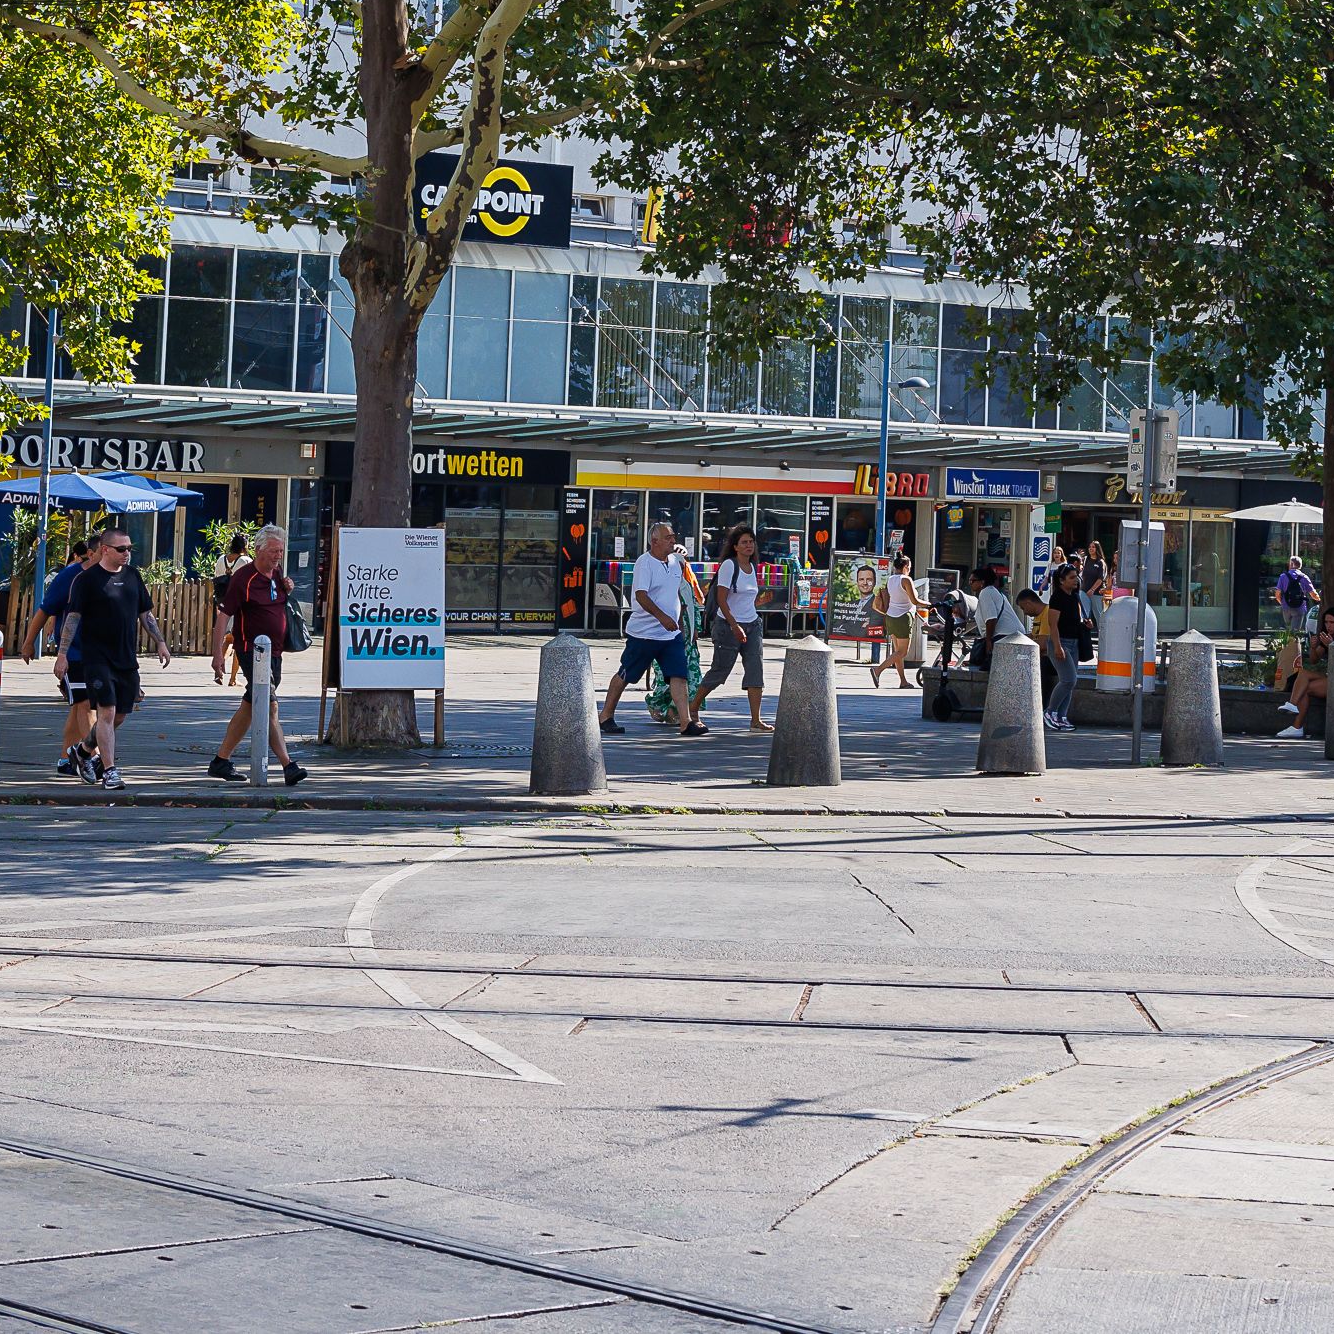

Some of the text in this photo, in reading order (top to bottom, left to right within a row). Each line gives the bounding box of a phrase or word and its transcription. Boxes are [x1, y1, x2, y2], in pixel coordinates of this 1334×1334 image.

[420, 184, 544, 216] CAPOINT
[412, 448, 524, 477] ortwetten
[954, 478, 1032, 496] Winston TABAK TRAFIK
[126, 500, 158, 512] ADMIRAL
[1032, 523, 1044, 532] Wins
[346, 564, 398, 581] Starke
[347, 583, 393, 600] Mitte.
[347, 602, 438, 623] Sicheres
[445, 612, 468, 620] YOUR
[350, 627, 436, 656] Wien.
